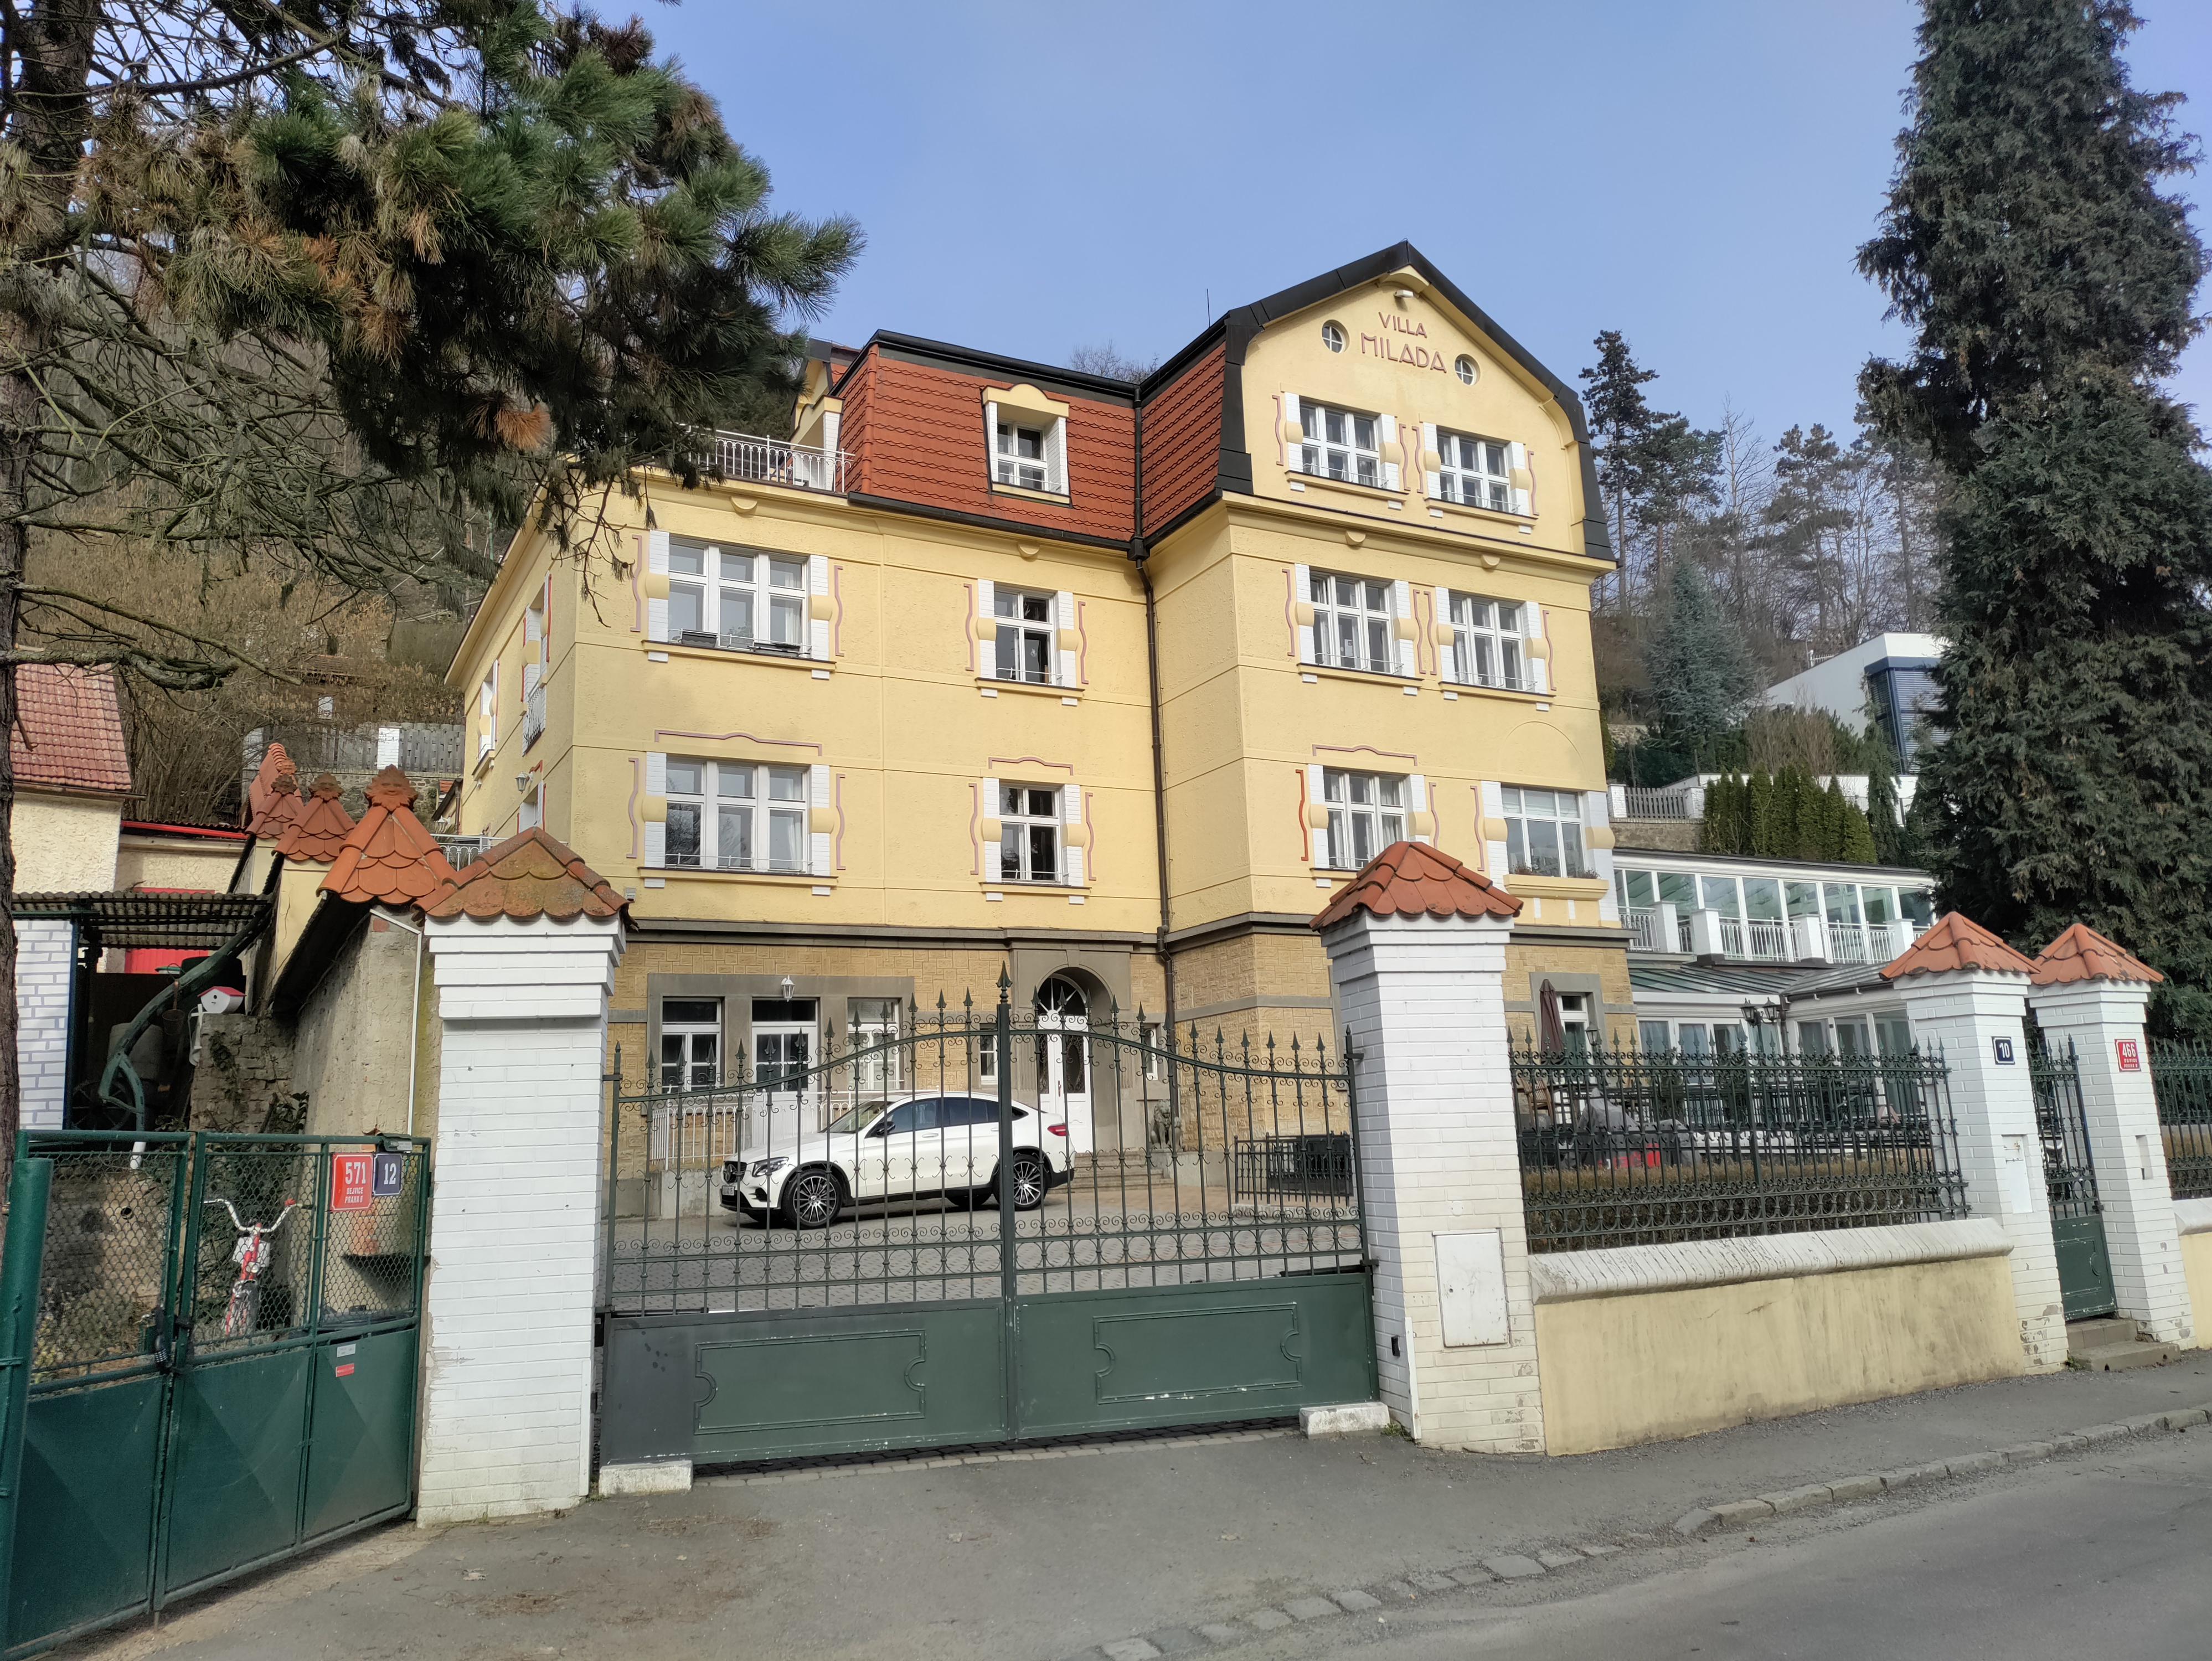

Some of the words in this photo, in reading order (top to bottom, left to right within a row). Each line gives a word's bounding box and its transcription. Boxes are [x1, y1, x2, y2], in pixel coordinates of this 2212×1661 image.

[1378, 312, 1427, 338] VILLA
[1361, 332, 1447, 373] MILADA
[1999, 1043, 2010, 1058] 10
[2122, 1043, 2136, 1058] 466
[345, 1162, 366, 1184] 571
[384, 1163, 396, 1184] 12
